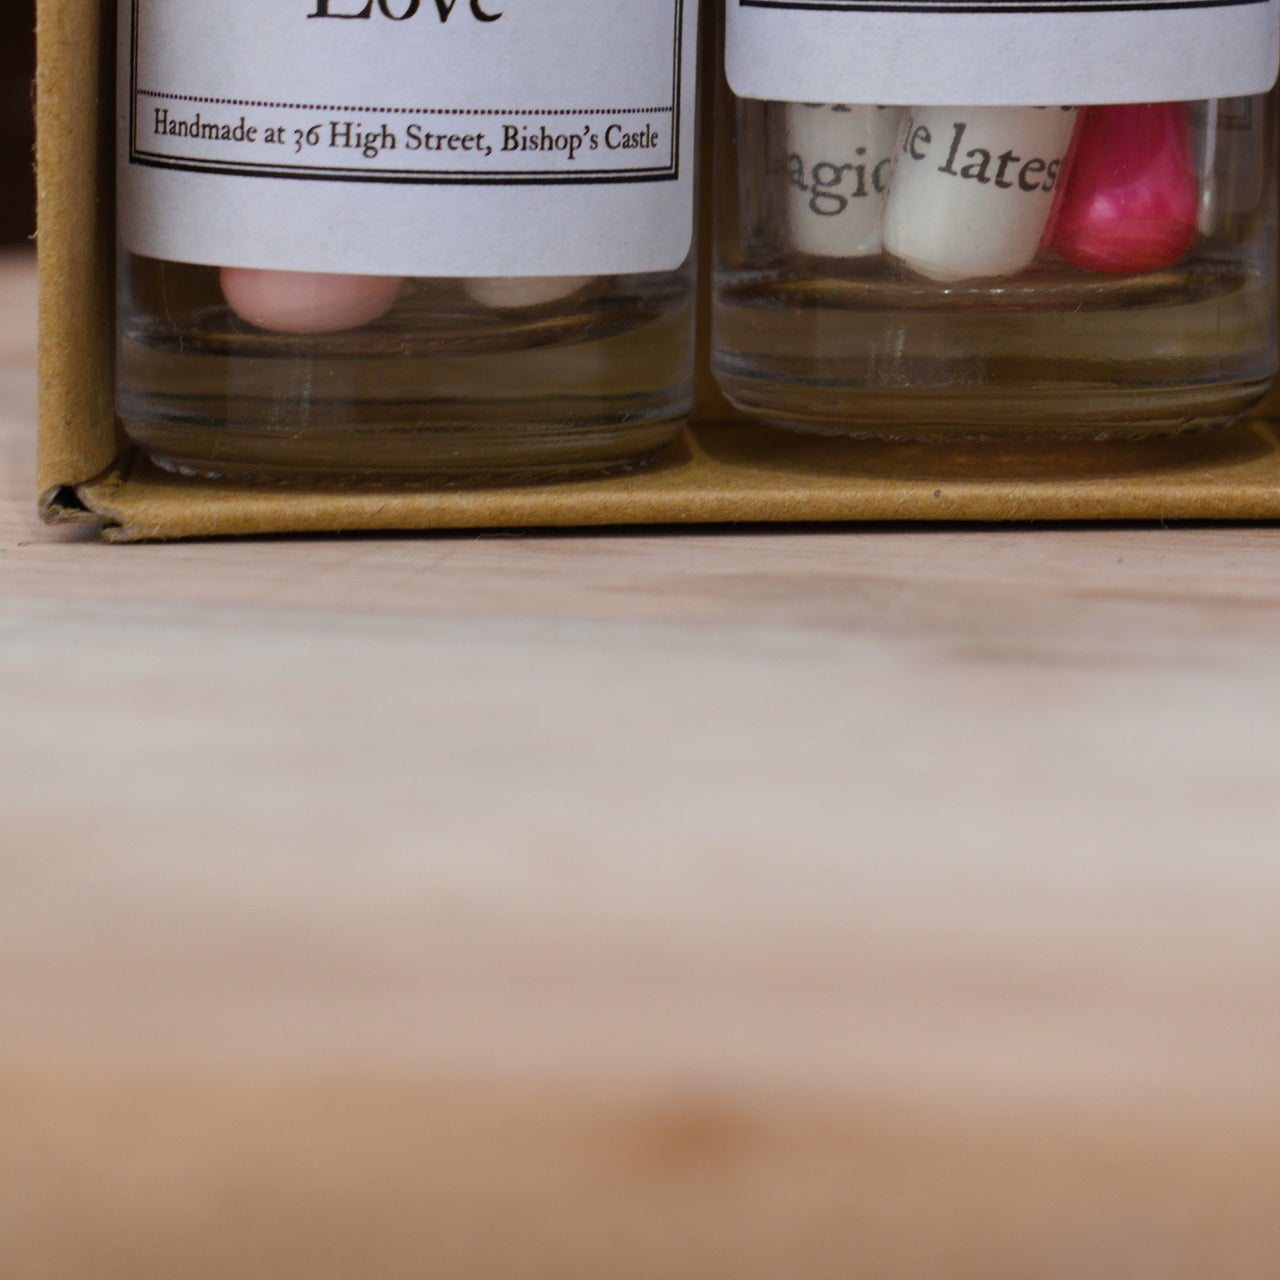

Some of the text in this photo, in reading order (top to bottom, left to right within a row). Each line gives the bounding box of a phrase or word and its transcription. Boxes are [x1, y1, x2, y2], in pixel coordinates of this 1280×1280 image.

[153, 108, 659, 160] Handmade at 36 High Street, Bishop's Castle
